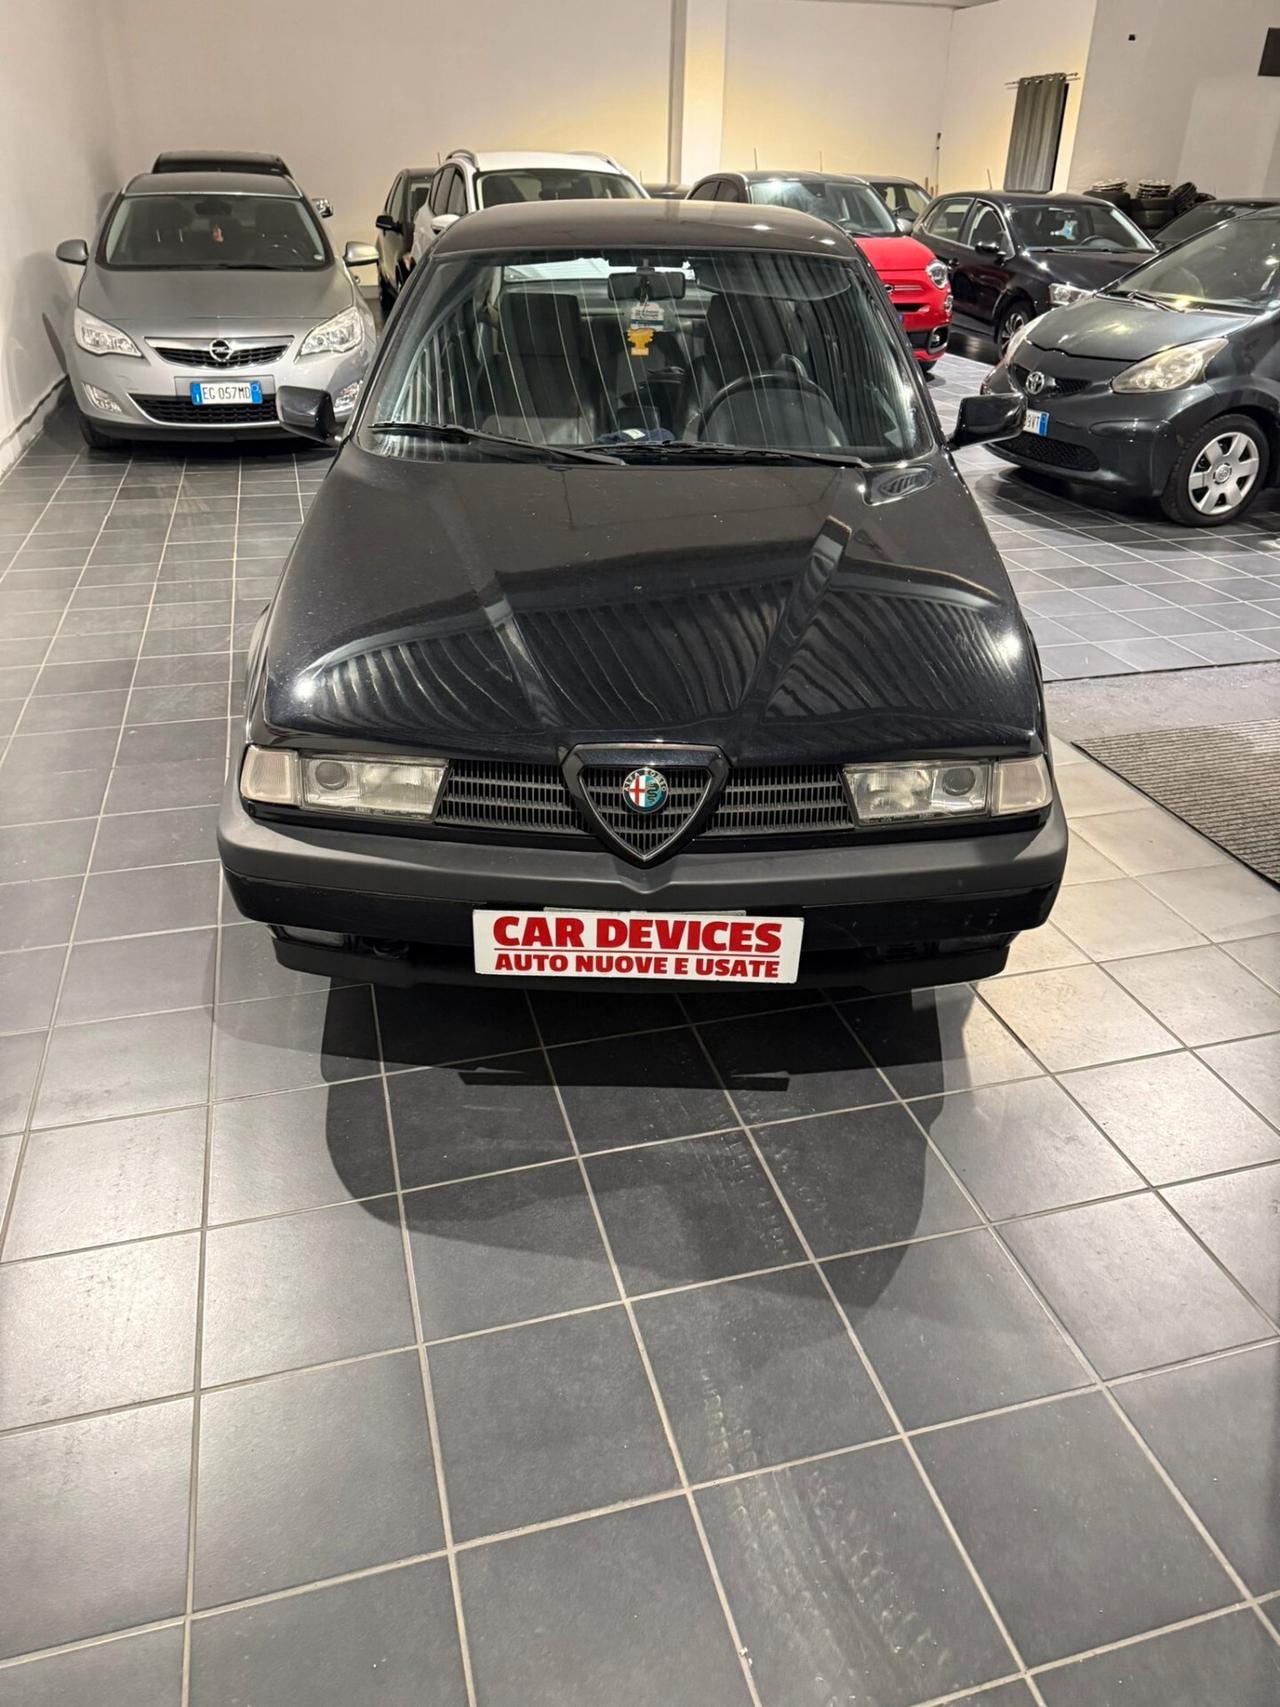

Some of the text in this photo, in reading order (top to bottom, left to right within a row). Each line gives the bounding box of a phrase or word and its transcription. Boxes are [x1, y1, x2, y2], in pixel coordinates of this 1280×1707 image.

[493, 916, 782, 953] CAR DEVICES
[495, 953, 780, 978] AUTO NUOVE E USATE
